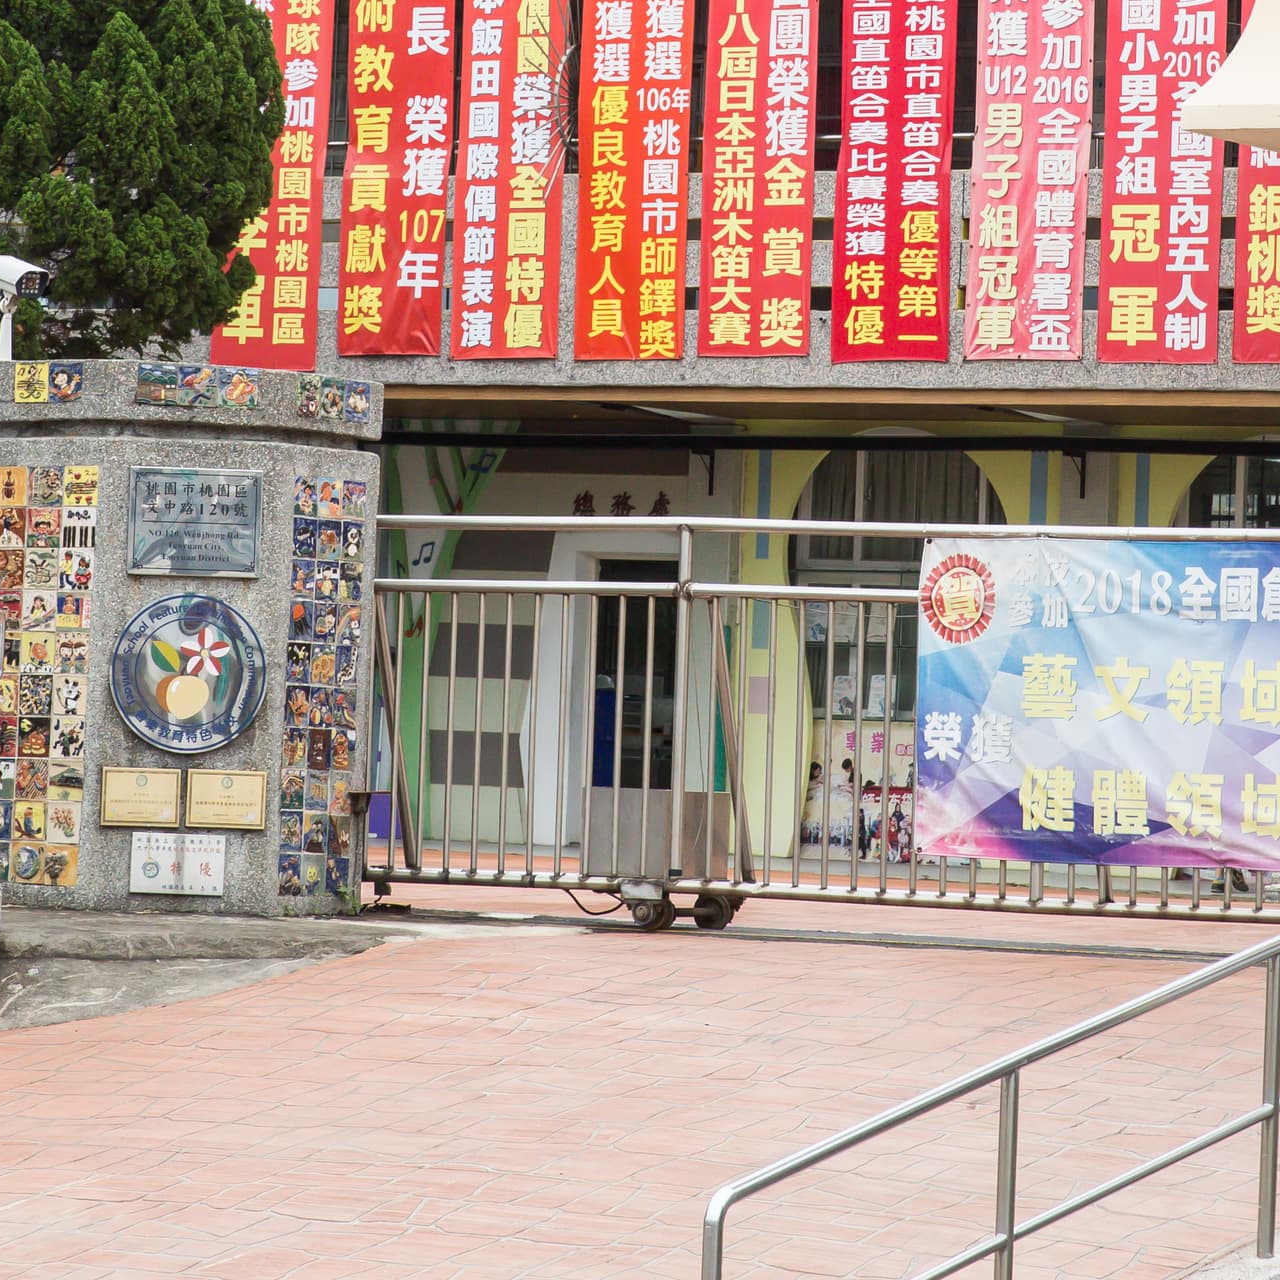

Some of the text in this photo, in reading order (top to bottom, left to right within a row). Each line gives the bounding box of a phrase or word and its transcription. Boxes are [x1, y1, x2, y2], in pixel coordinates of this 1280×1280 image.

[146, 480, 248, 498] 桃園市桃園區
[147, 500, 248, 517] 文中路120號
[938, 575, 982, 623] 賀
[124, 623, 149, 655] School
[923, 712, 1016, 763] 榮獲
